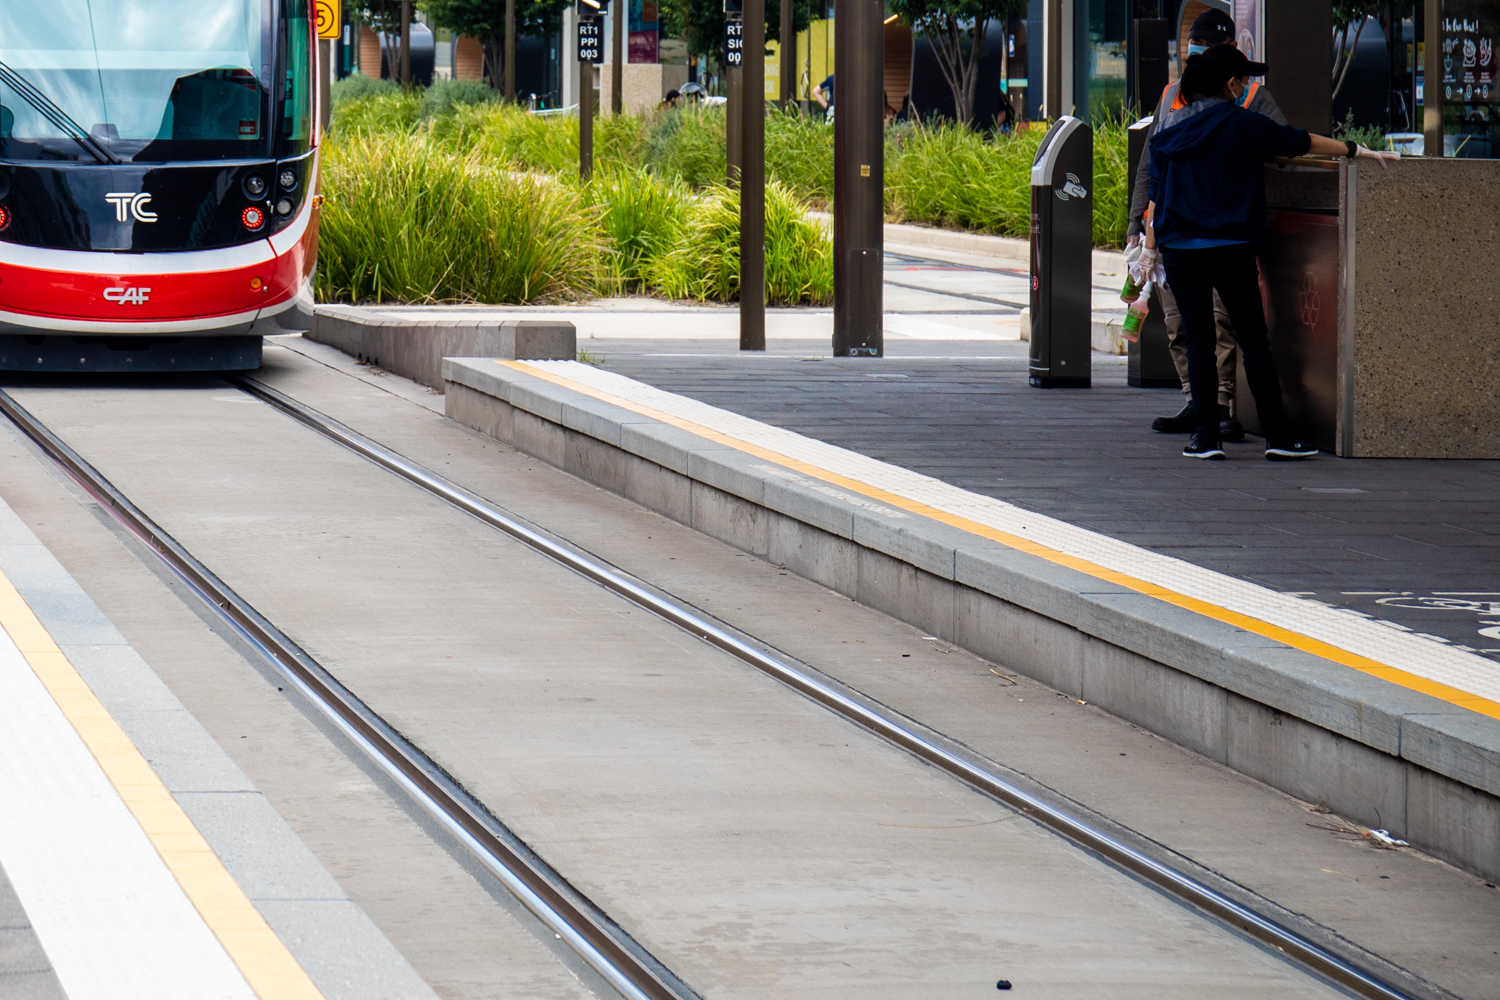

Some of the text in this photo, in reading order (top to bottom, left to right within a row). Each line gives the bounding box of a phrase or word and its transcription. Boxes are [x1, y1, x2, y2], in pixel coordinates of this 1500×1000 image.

[580, 25, 598, 35] RT1
[581, 37, 598, 46] PPI
[580, 49, 598, 58] 003
[105, 192, 158, 223] TC
[103, 287, 151, 305] CAF
